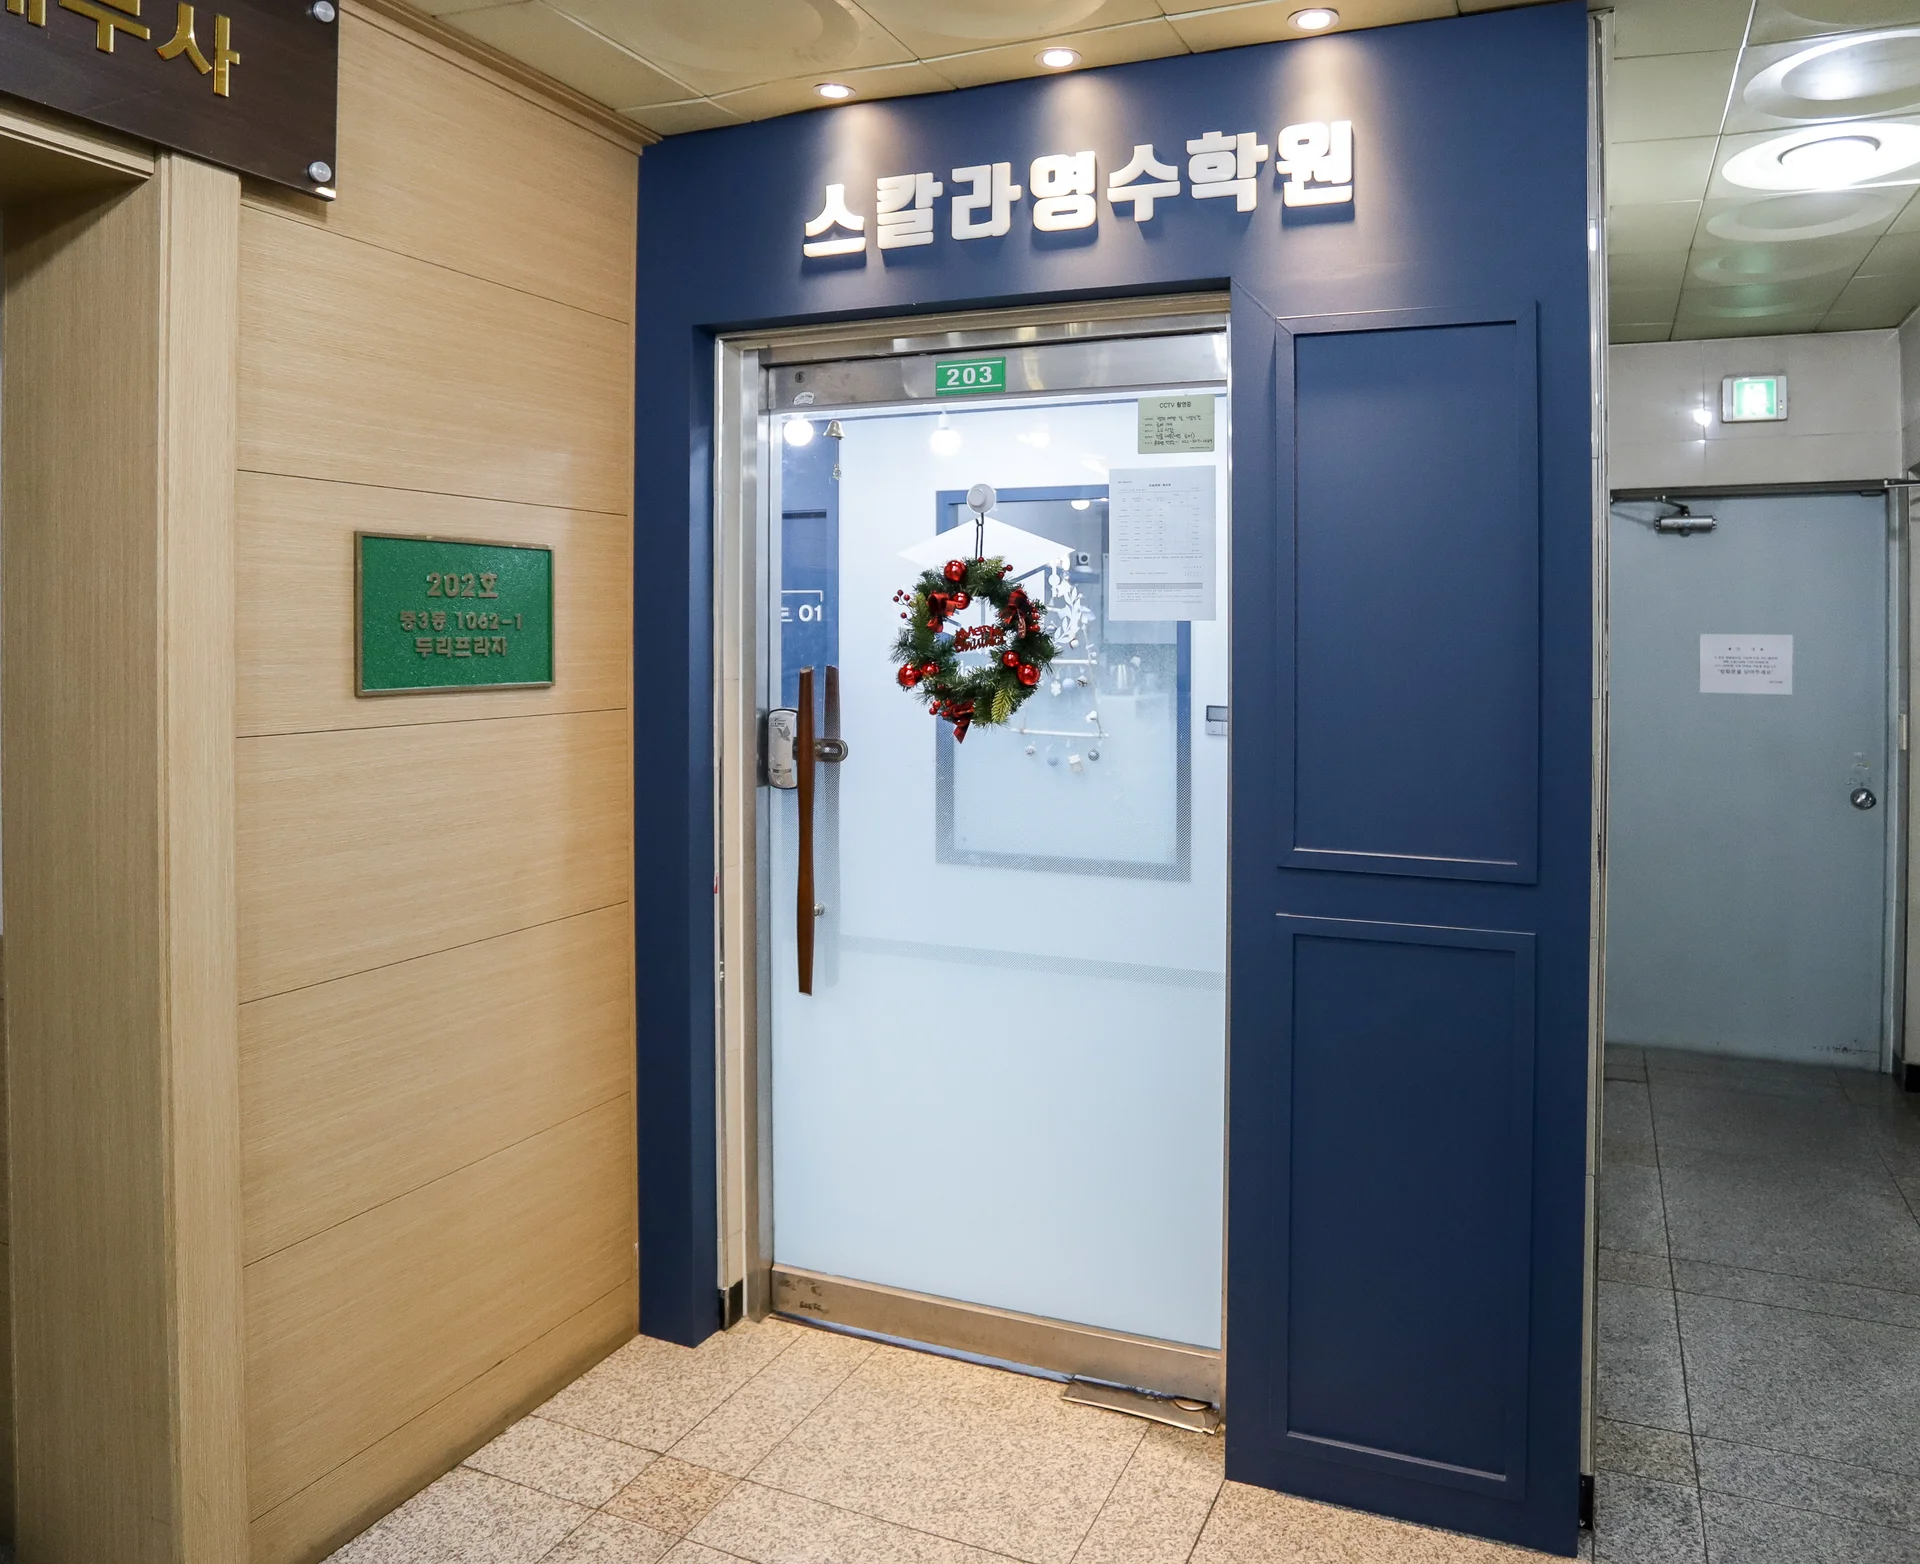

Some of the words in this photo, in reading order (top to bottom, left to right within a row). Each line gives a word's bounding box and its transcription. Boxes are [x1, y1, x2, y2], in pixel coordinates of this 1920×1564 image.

[803, 119, 1353, 258] 스칼라영수학원
[945, 365, 993, 387] 203
[426, 571, 499, 599] 202호
[455, 611, 523, 630] 1062-1
